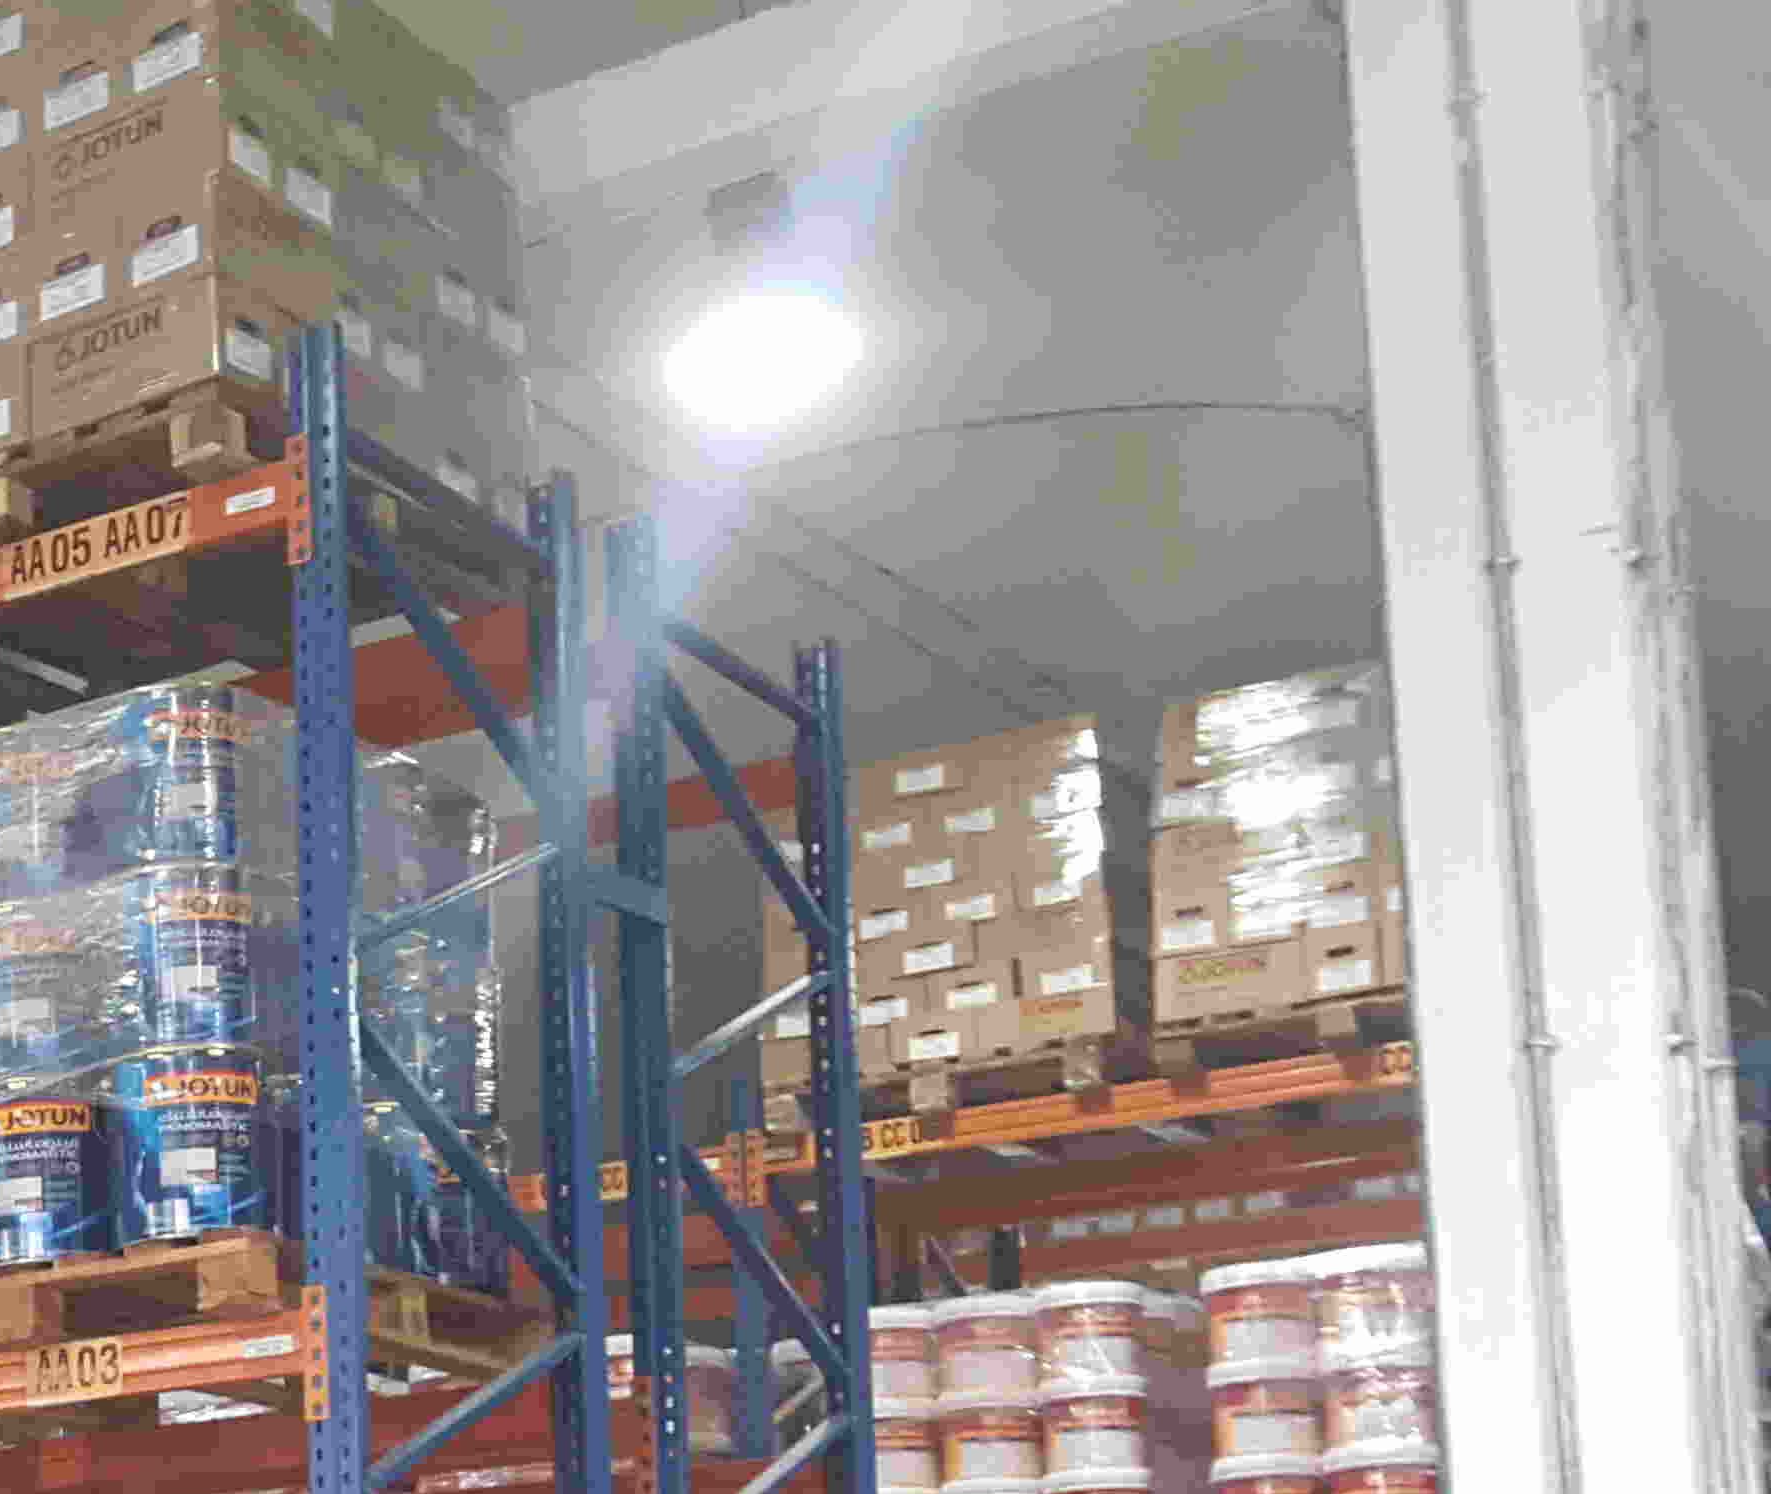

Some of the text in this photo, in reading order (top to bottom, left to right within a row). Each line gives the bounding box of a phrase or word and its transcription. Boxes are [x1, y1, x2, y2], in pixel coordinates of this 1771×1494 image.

[77, 110, 163, 170] JOTUN
[76, 306, 162, 362] JOTUN
[11, 527, 92, 584] AA05
[179, 1072, 254, 1095] JOTUN
[2, 1106, 87, 1131] JOTUN
[36, 1343, 121, 1393] AA03
